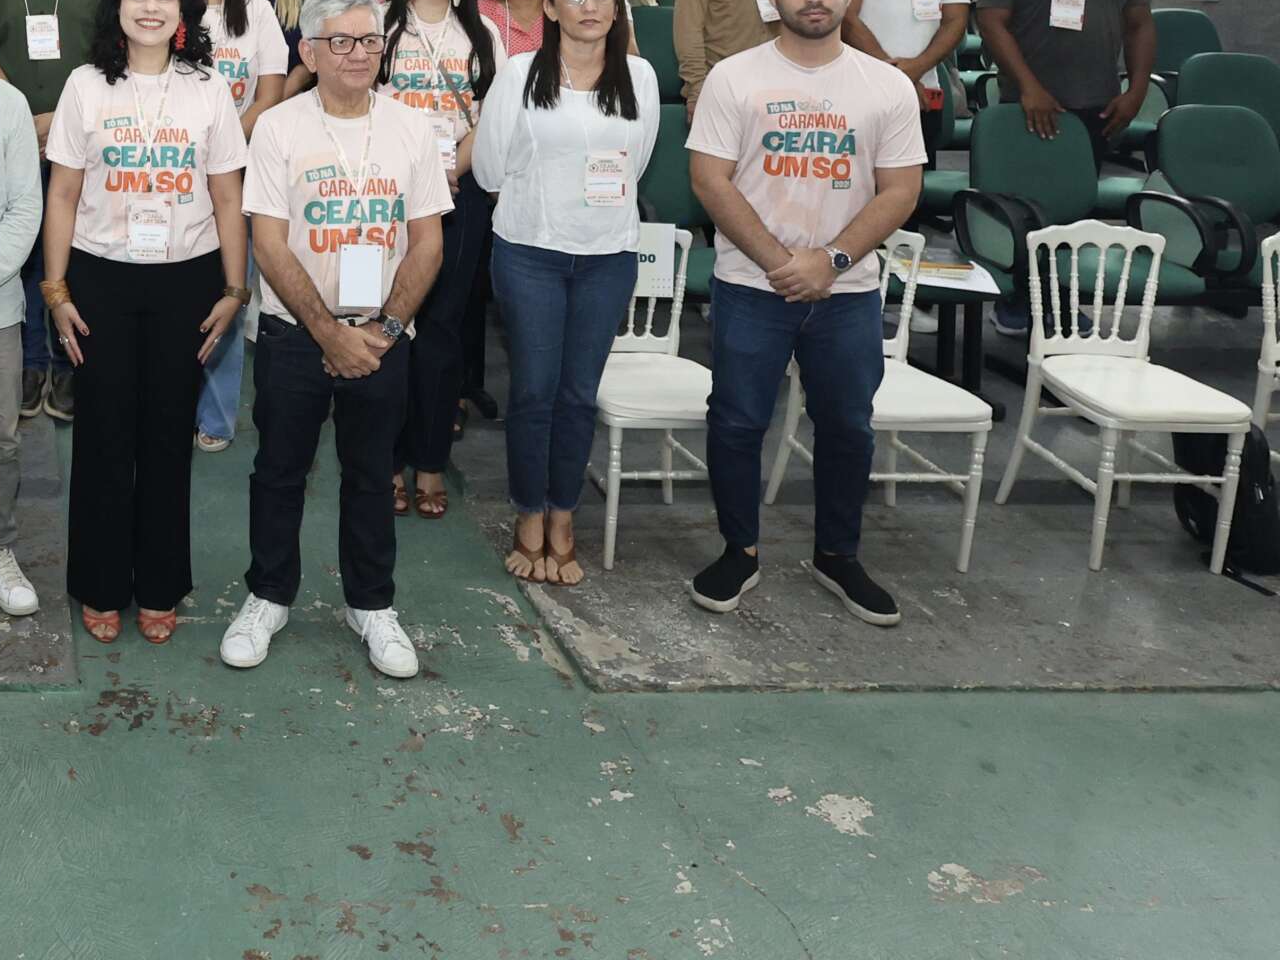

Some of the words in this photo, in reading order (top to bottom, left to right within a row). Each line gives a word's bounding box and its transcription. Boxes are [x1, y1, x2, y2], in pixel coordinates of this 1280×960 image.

[778, 113, 848, 130] CARAVANA
[102, 141, 197, 168] CEARÁ
[761, 128, 857, 155] CEARÁ
[105, 170, 150, 193] UM
[155, 166, 194, 194] SÓ
[763, 154, 809, 178] UM
[812, 152, 851, 181] SÓ
[303, 192, 406, 225] CEARÁ
[309, 227, 359, 254] UM
[366, 219, 398, 250] SÓ
[639, 253, 656, 263] DO
